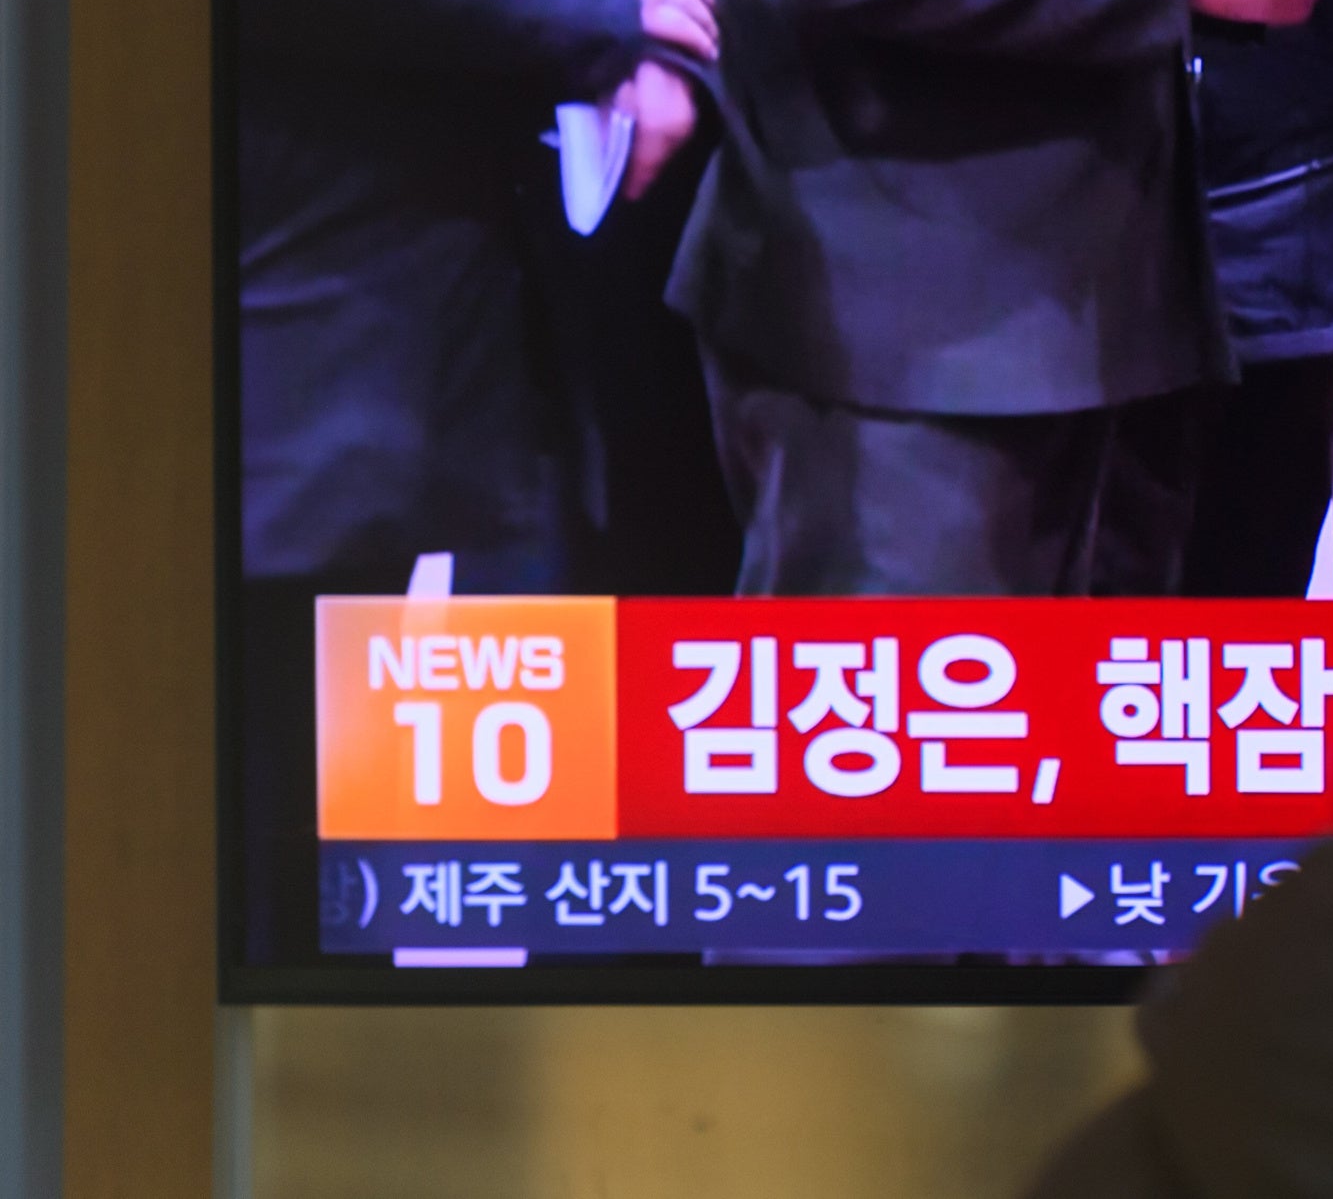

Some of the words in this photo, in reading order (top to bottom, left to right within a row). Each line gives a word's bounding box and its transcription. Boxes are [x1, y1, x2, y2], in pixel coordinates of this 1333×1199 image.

[368, 635, 565, 690] NEWS
[667, 633, 1061, 805] 김정은,
[392, 701, 552, 806] 10
[400, 860, 528, 928] 제주
[545, 860, 669, 927] 산지
[693, 862, 863, 923] 5~15
[1109, 860, 1172, 926] 낮
